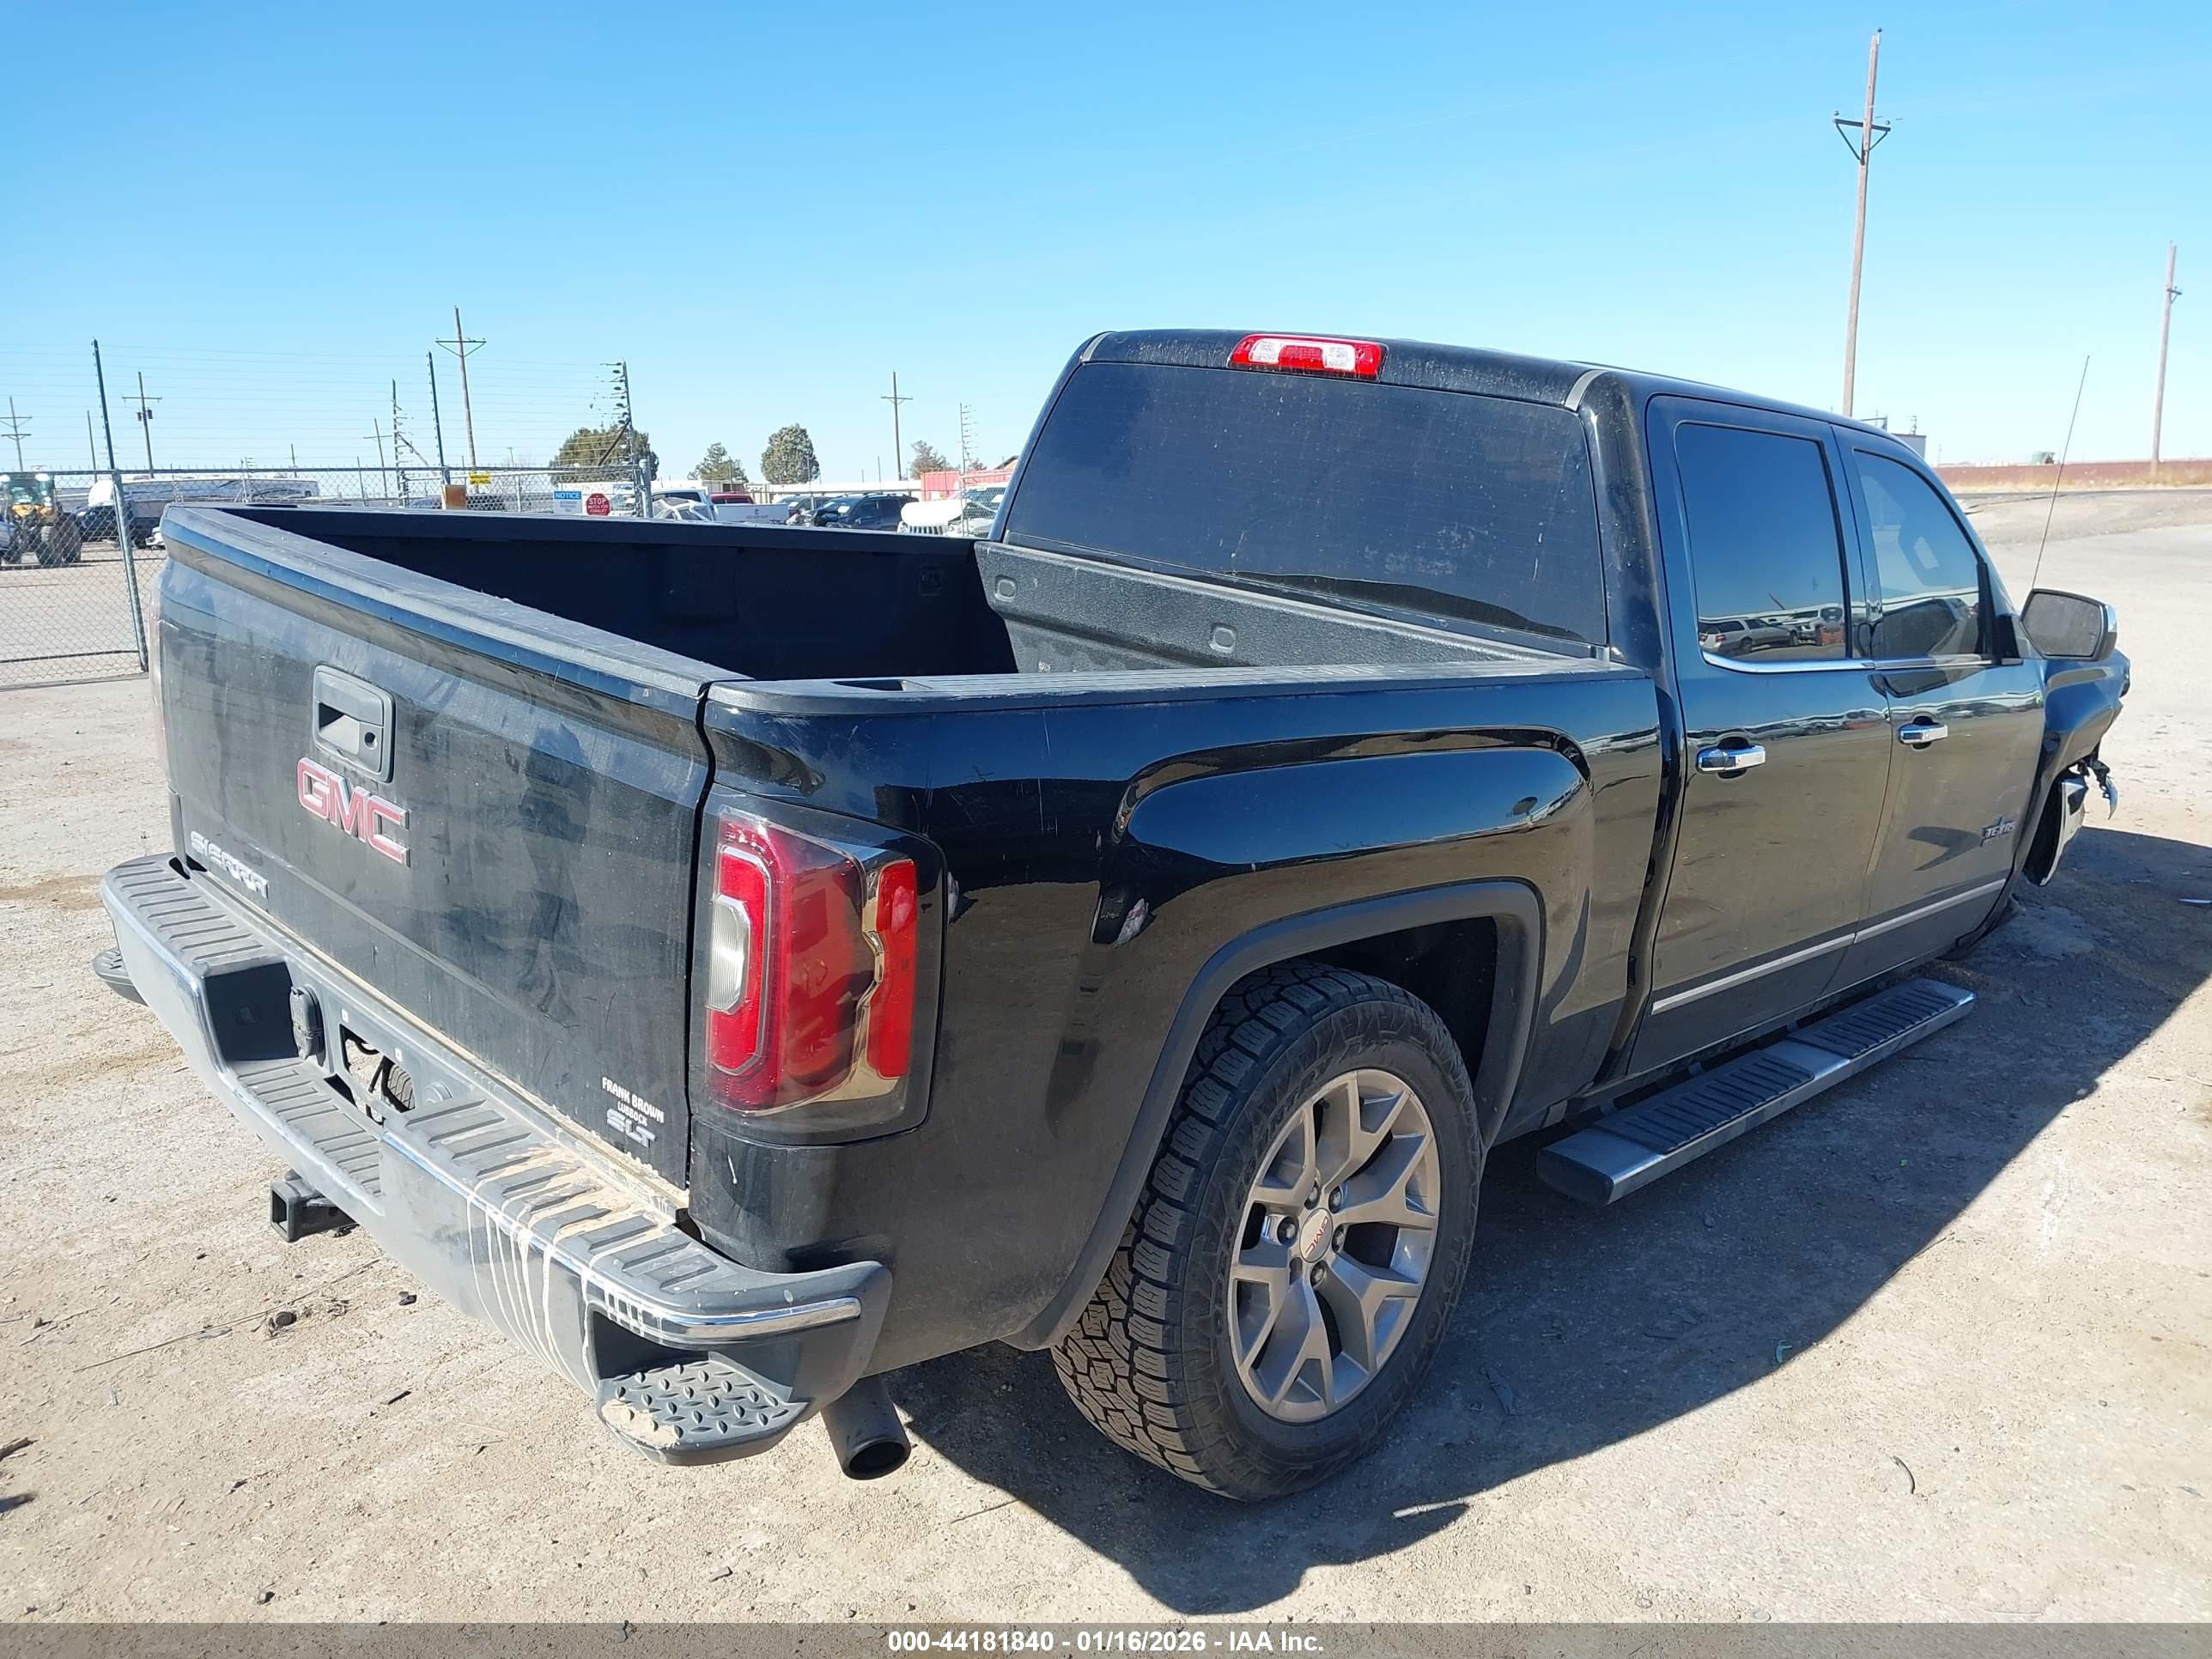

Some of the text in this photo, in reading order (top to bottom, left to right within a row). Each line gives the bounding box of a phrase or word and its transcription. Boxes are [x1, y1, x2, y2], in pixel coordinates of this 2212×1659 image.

[296, 757, 410, 867] GMC
[1986, 822, 2015, 837] TEXAS
[190, 830, 269, 899] SIERRA
[602, 1077, 665, 1124] FRANK BROWN
[617, 1100, 648, 1127] LUBBOCK
[606, 1108, 656, 1148] SLT
[1305, 1216, 1328, 1256] GMC
